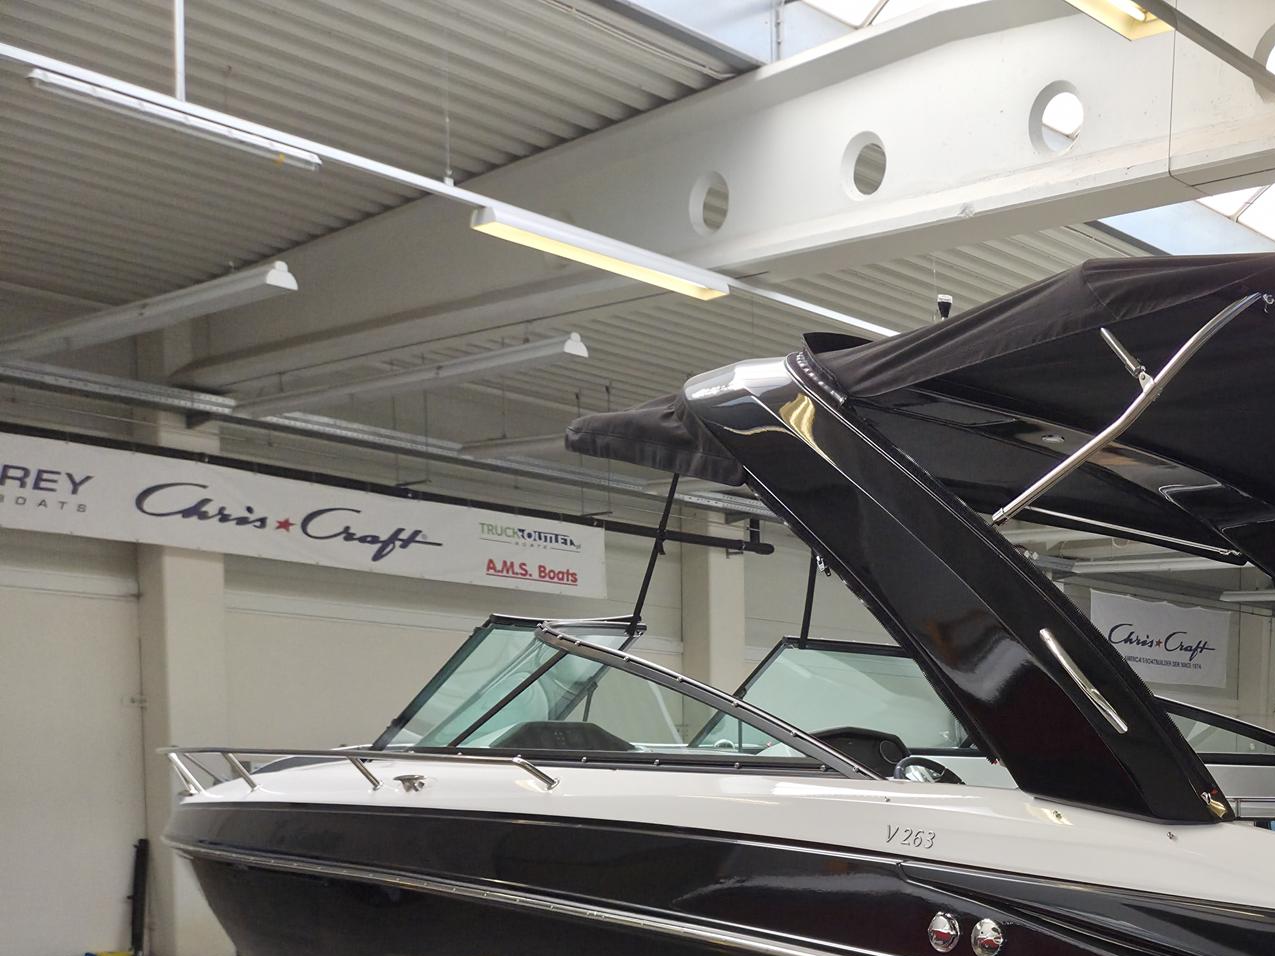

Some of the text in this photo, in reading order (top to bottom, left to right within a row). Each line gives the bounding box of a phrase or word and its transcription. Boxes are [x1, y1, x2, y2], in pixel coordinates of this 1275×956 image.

[0, 464, 94, 495] REY
[135, 482, 443, 562] Chris Craft
[486, 558, 578, 584] A.M.S. Boats
[1108, 623, 1216, 662] Chris Craft
[886, 824, 936, 849] V 263
